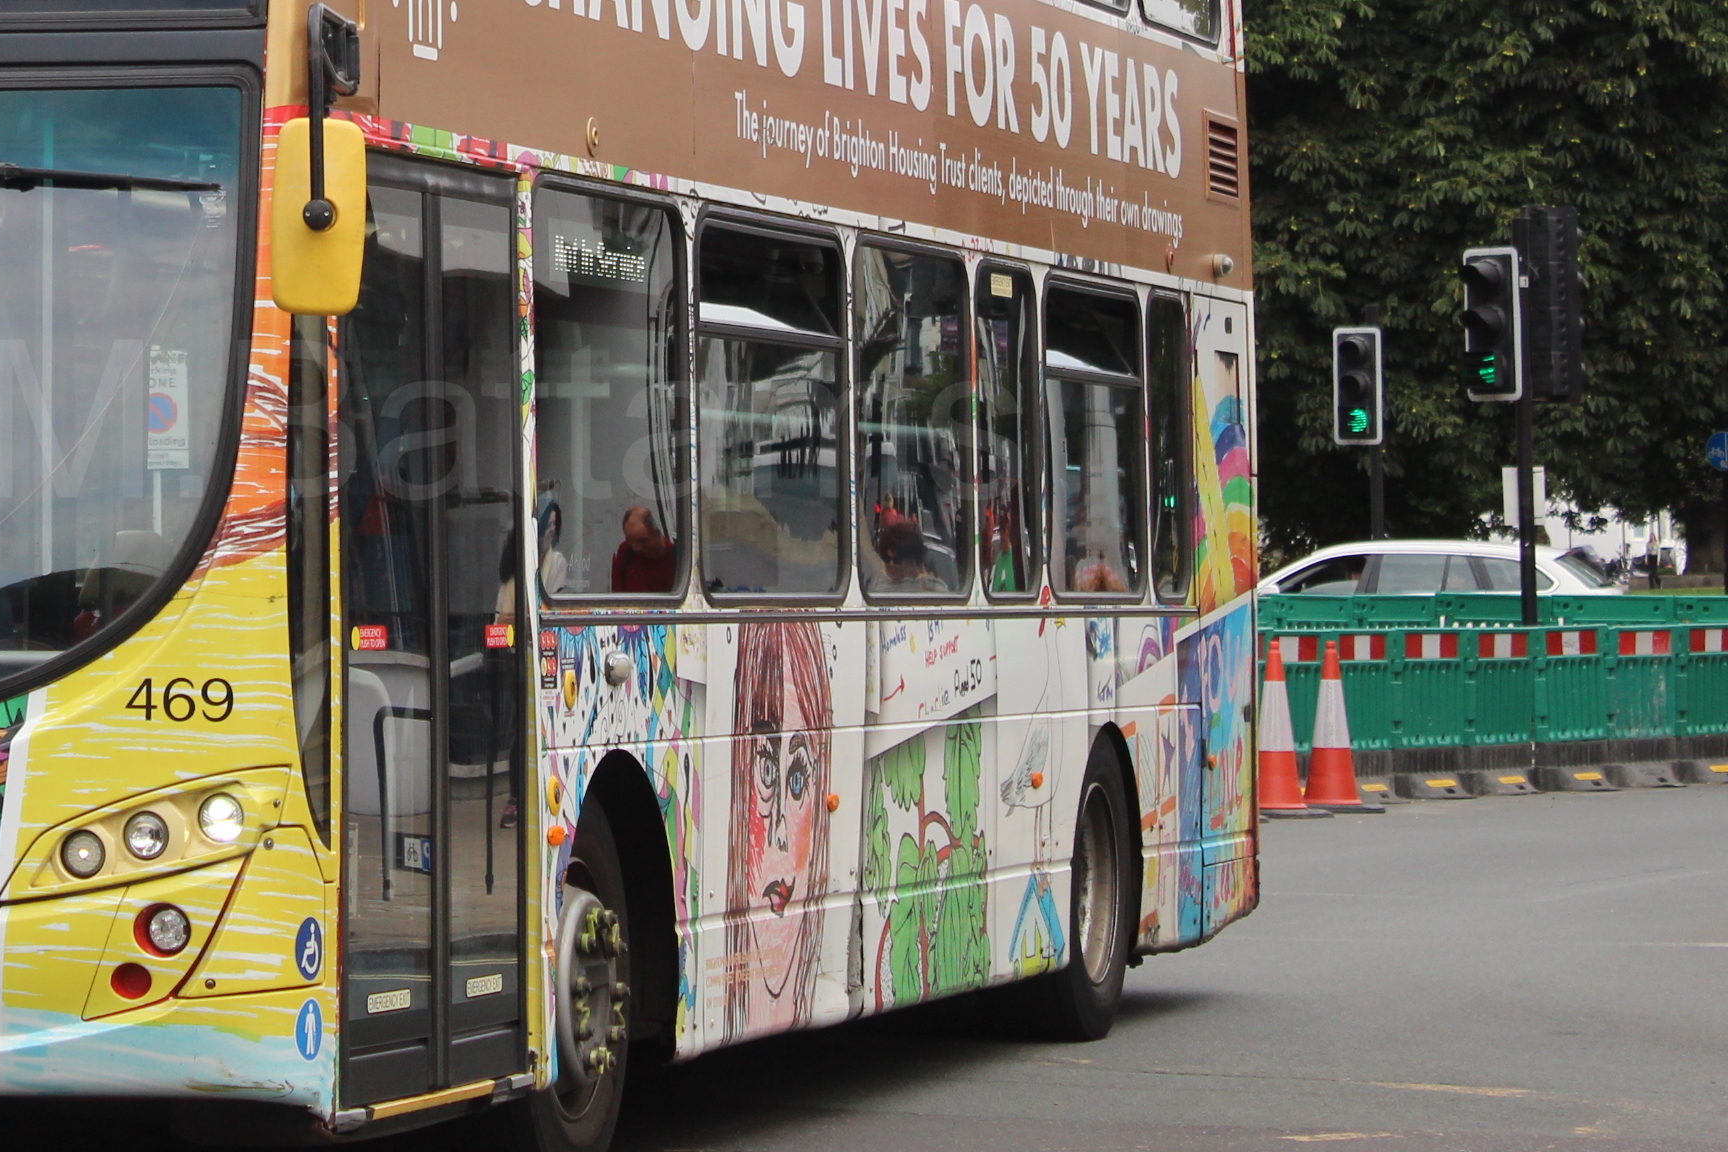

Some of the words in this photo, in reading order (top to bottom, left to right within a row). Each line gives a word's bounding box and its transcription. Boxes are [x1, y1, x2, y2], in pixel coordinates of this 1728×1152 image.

[1030, 25, 1072, 149] 50
[1079, 40, 1182, 179] YEARS
[735, 91, 759, 142] The
[762, 99, 814, 169] journey
[817, 110, 831, 158] of
[833, 113, 886, 179] Brighton
[889, 130, 938, 195] Housing
[940, 142, 966, 189] Trust
[968, 147, 1007, 206] clients,
[1008, 156, 1054, 215] depicted
[1055, 168, 1094, 228] through
[1096, 176, 1119, 219] their
[1120, 199, 1141, 229] own
[1141, 191, 1184, 249] drawings
[555, 234, 578, 274] Not
[596, 241, 645, 283] Service
[148, 377, 178, 389] ONE
[359, 627, 383, 639] EMERGENCY
[359, 638, 370, 649] PUSH
[376, 637, 386, 648] OPEN
[924, 647, 938, 668] HELP
[970, 658, 983, 692] 50
[124, 677, 234, 723] 469
[467, 977, 492, 996] EMERGENCY
[492, 975, 503, 991] EXIT
[368, 992, 398, 1013] EMERGENCY
[398, 990, 411, 1007] EXIT
